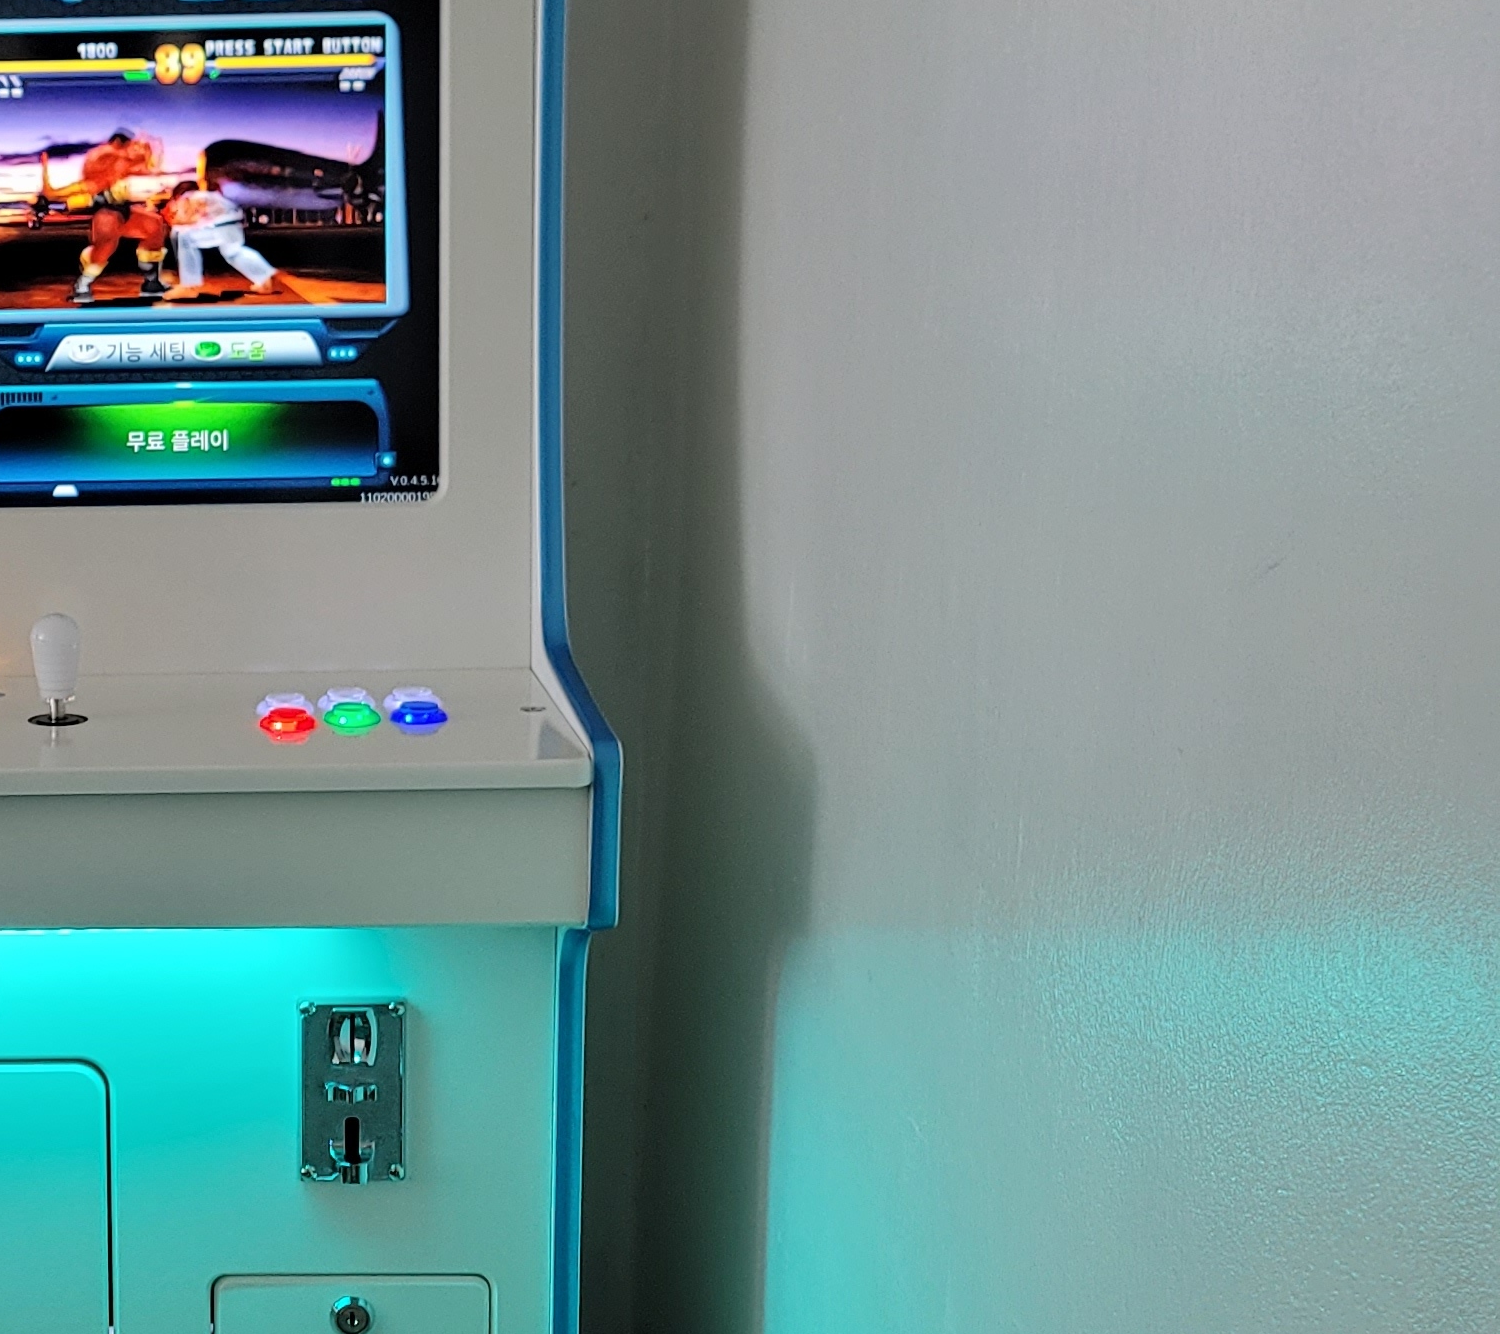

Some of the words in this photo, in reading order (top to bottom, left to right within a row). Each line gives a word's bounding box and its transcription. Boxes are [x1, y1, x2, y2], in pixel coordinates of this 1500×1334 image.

[205, 39, 255, 58] PRESS
[263, 38, 314, 56] START
[322, 37, 383, 55] BUTTON
[154, 44, 206, 86] 89
[106, 341, 143, 363] 기능
[149, 340, 186, 362] 세팅
[227, 340, 266, 362] 도움
[127, 432, 165, 451] 무료
[171, 429, 229, 451] 플레이
